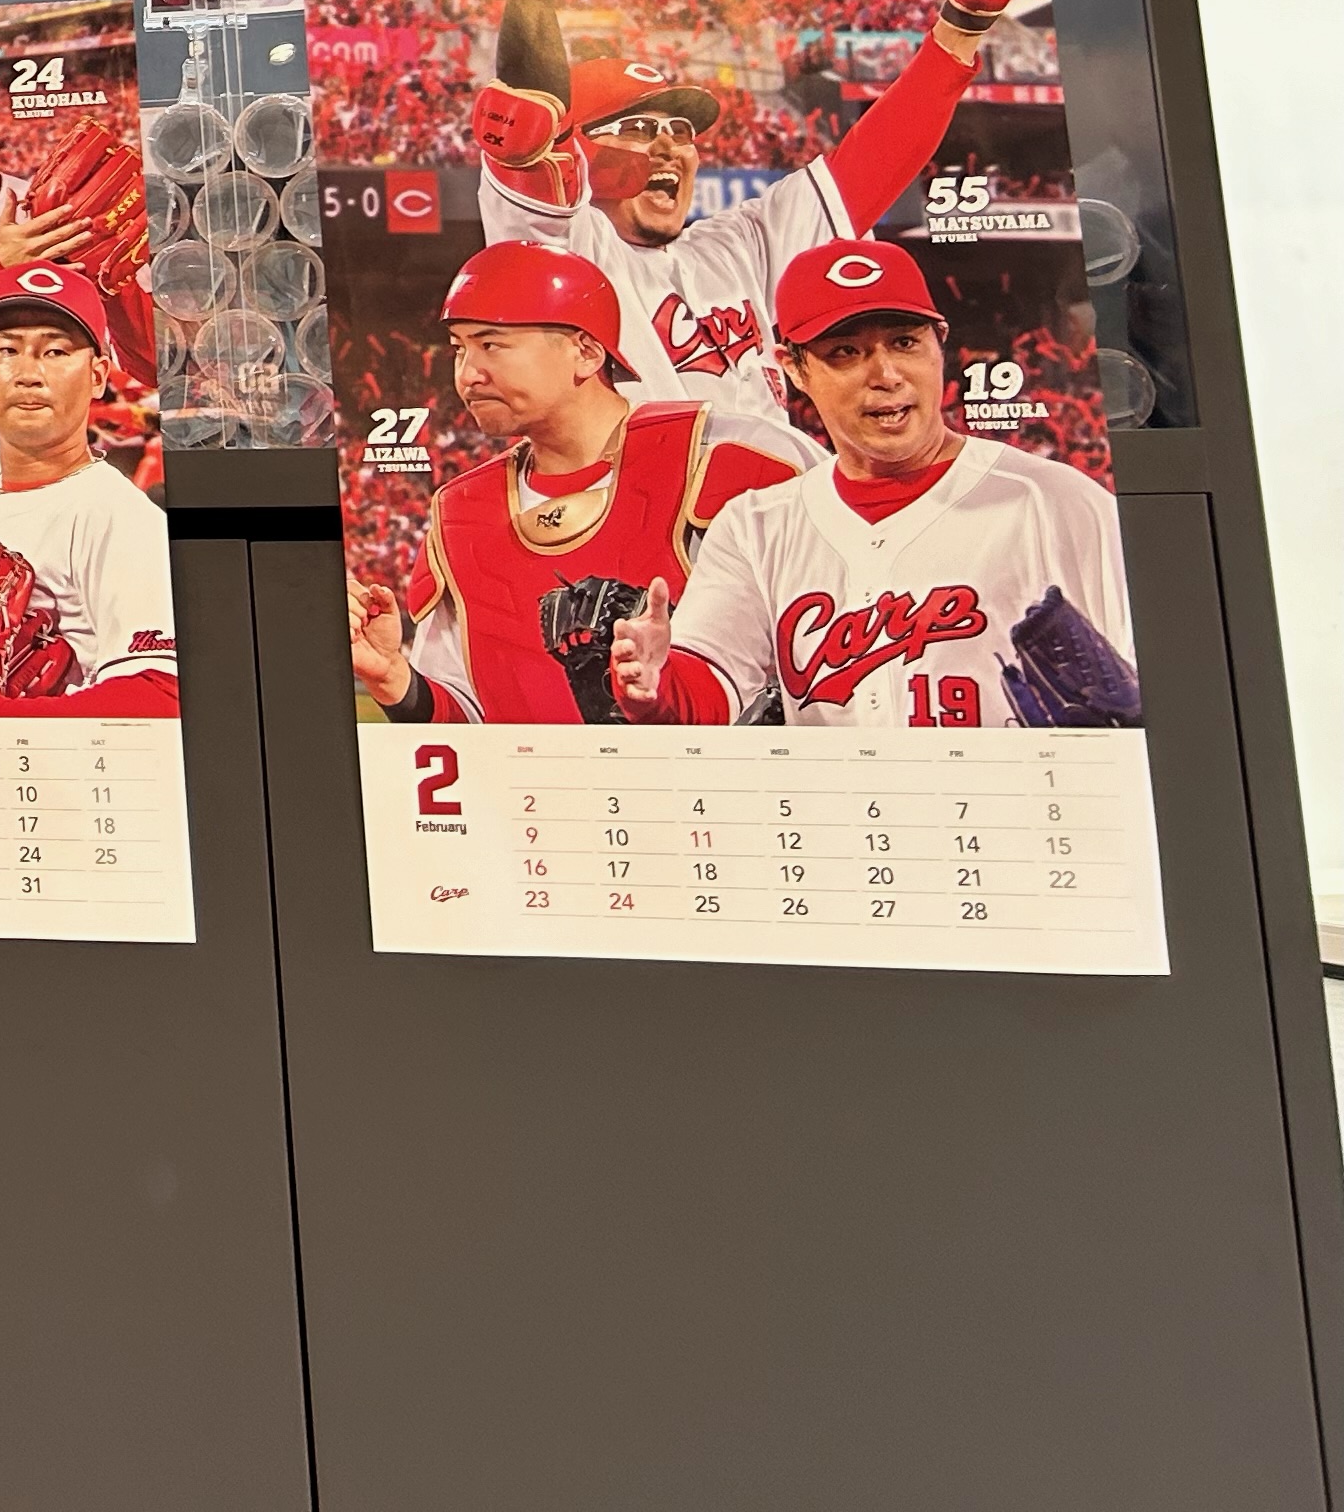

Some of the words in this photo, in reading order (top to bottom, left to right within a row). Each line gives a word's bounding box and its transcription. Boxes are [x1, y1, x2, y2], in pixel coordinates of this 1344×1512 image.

[9, 57, 65, 93] 24
[11, 91, 109, 109] KUROHARA
[925, 175, 991, 215] 55
[928, 214, 1051, 232] MATSUYAMA
[963, 361, 1024, 401] 19
[964, 402, 1050, 419] NOMURA
[367, 408, 430, 445] 27
[362, 447, 431, 462] AIZAWA
[776, 585, 988, 711] Carp
[908, 674, 982, 728] 19
[415, 744, 462, 816] 2
[524, 795, 536, 812] 2
[607, 797, 620, 814] 3
[692, 798, 705, 815] 4
[780, 800, 792, 817] 5
[867, 801, 881, 818] 6
[955, 802, 968, 820] 7
[1048, 803, 1062, 821] 8
[18, 816, 38, 832] 17
[94, 818, 115, 834] 18
[416, 821, 467, 835] February
[526, 827, 538, 844] 9
[605, 829, 629, 846] 10
[690, 831, 712, 848] 11
[777, 832, 803, 849] 12
[865, 834, 891, 852] 13
[954, 835, 981, 853] 14
[1046, 837, 1072, 855] 15
[21, 877, 41, 893] 31
